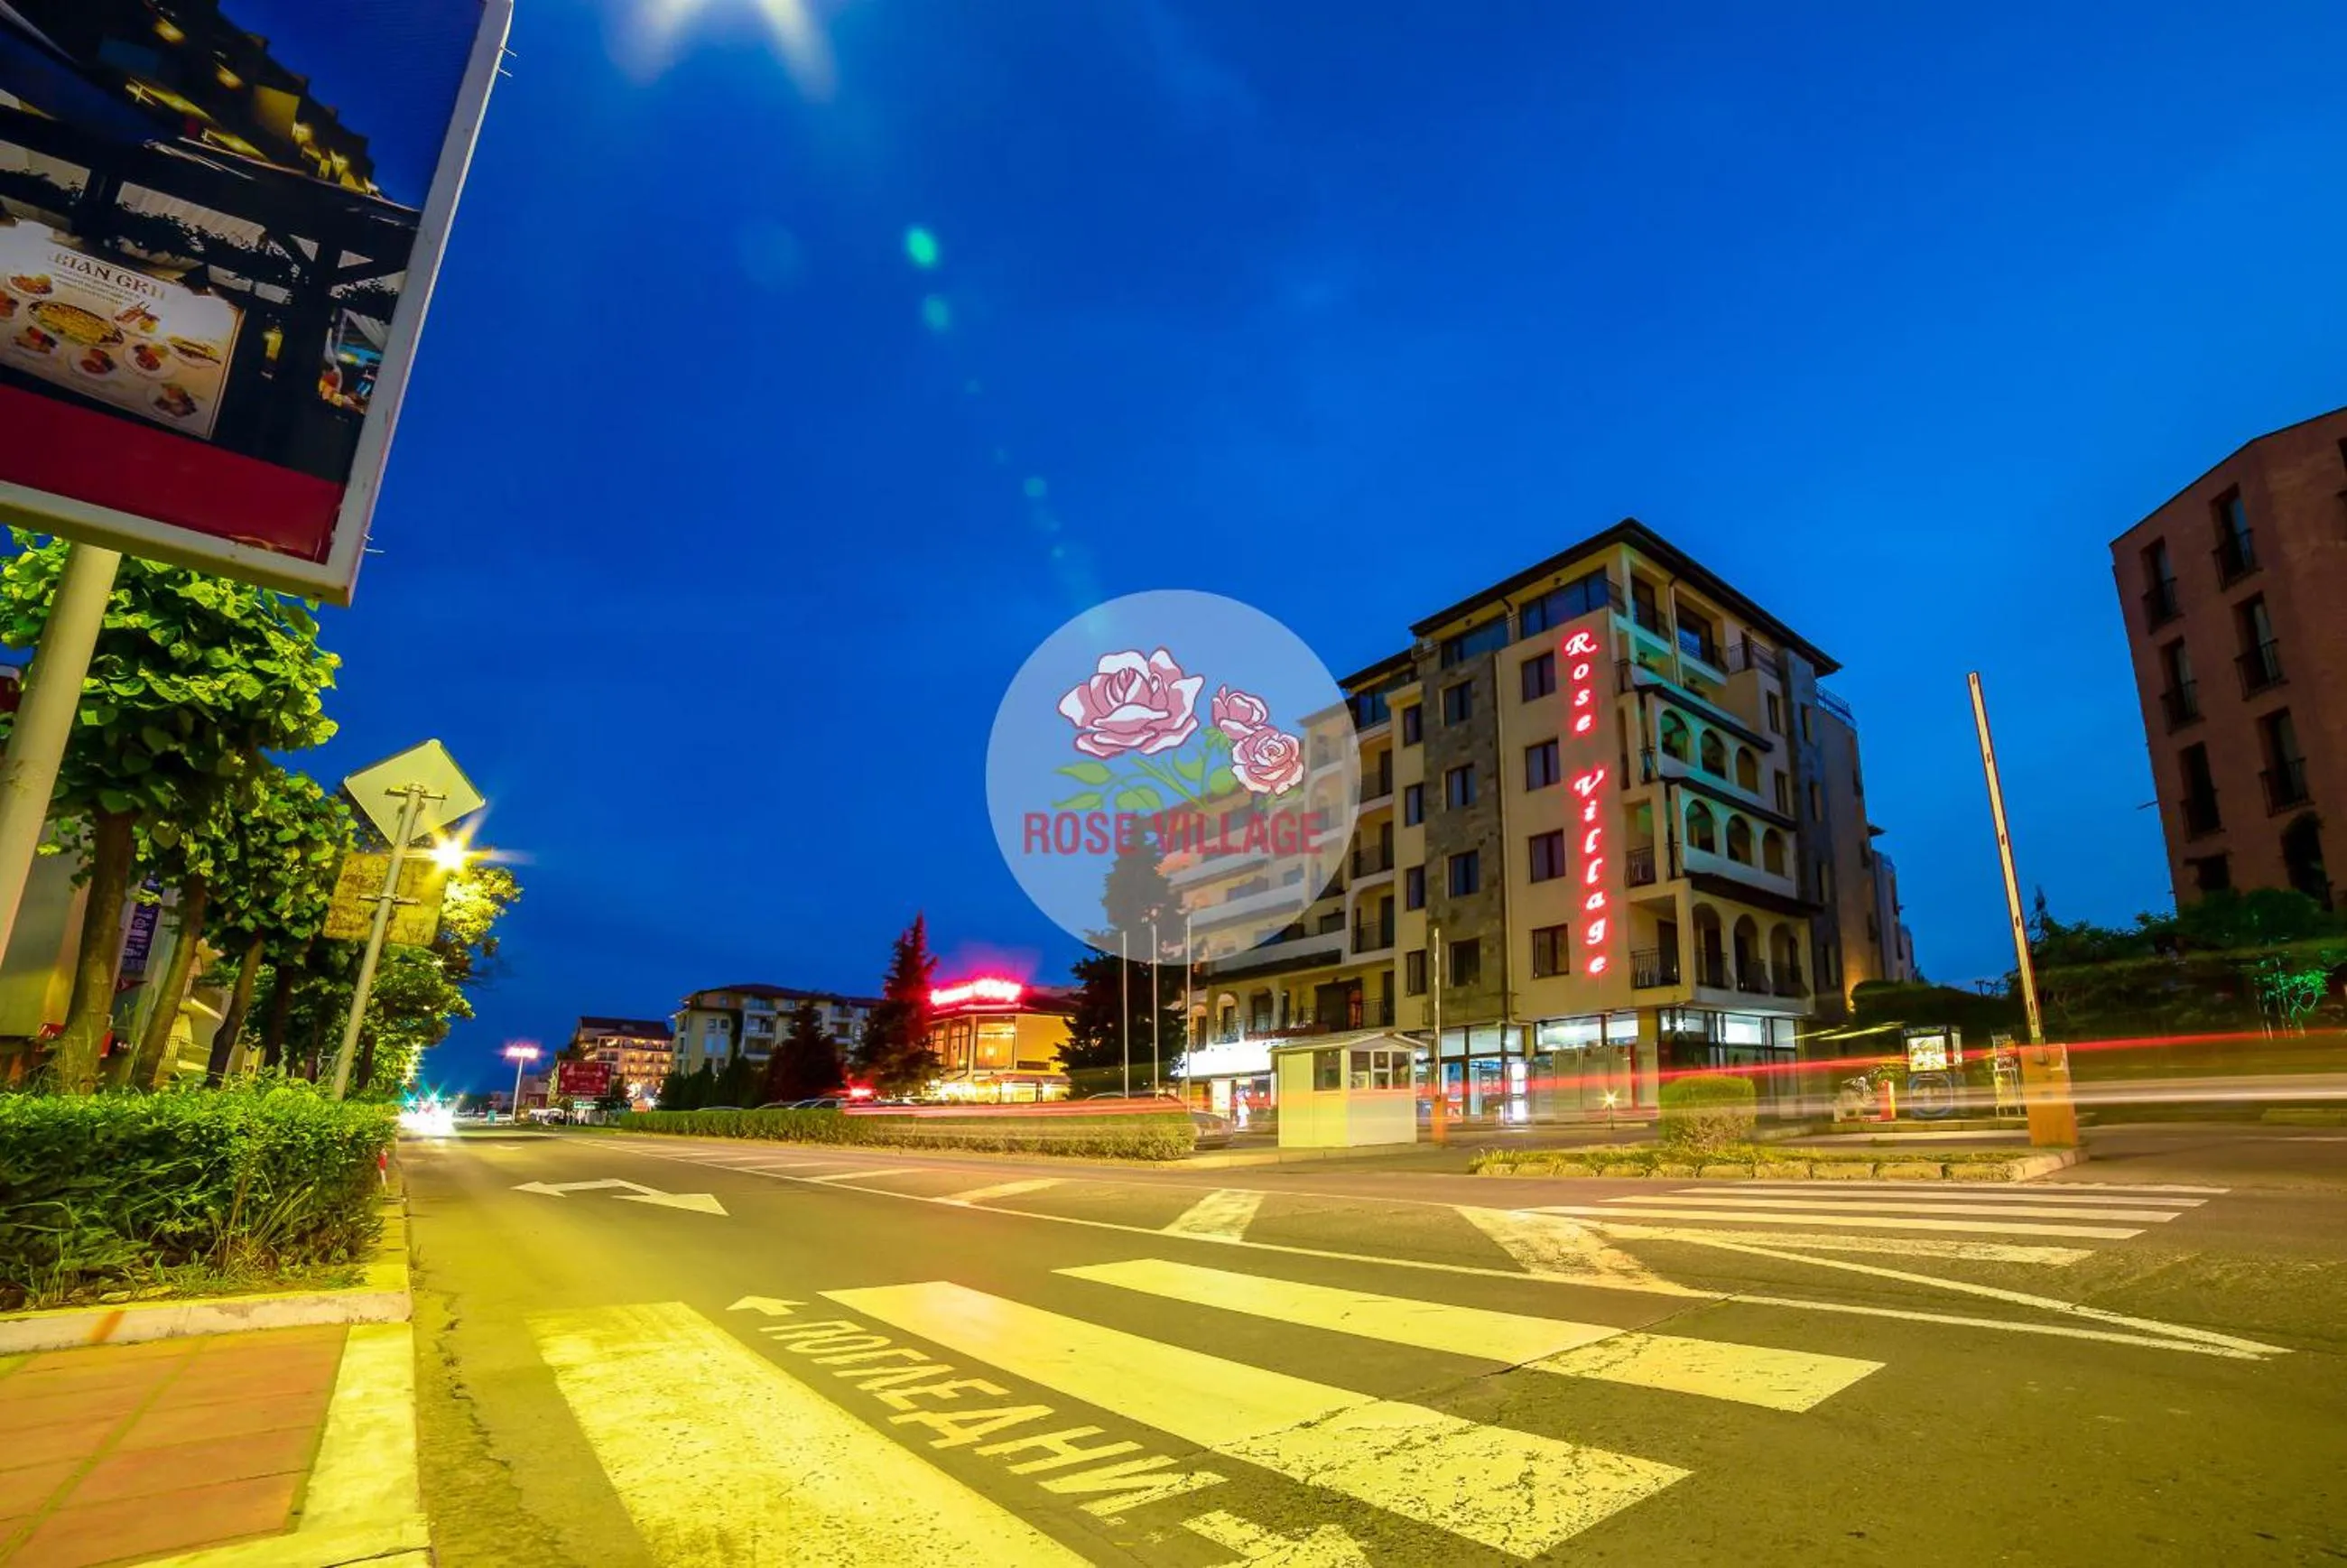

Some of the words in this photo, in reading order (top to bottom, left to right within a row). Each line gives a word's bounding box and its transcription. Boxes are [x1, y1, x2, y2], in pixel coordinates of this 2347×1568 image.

[1565, 632, 1597, 732] Rose
[1574, 768, 1605, 973] Village
[758, 1320, 1229, 1518] ПОГЛЕДНИ
